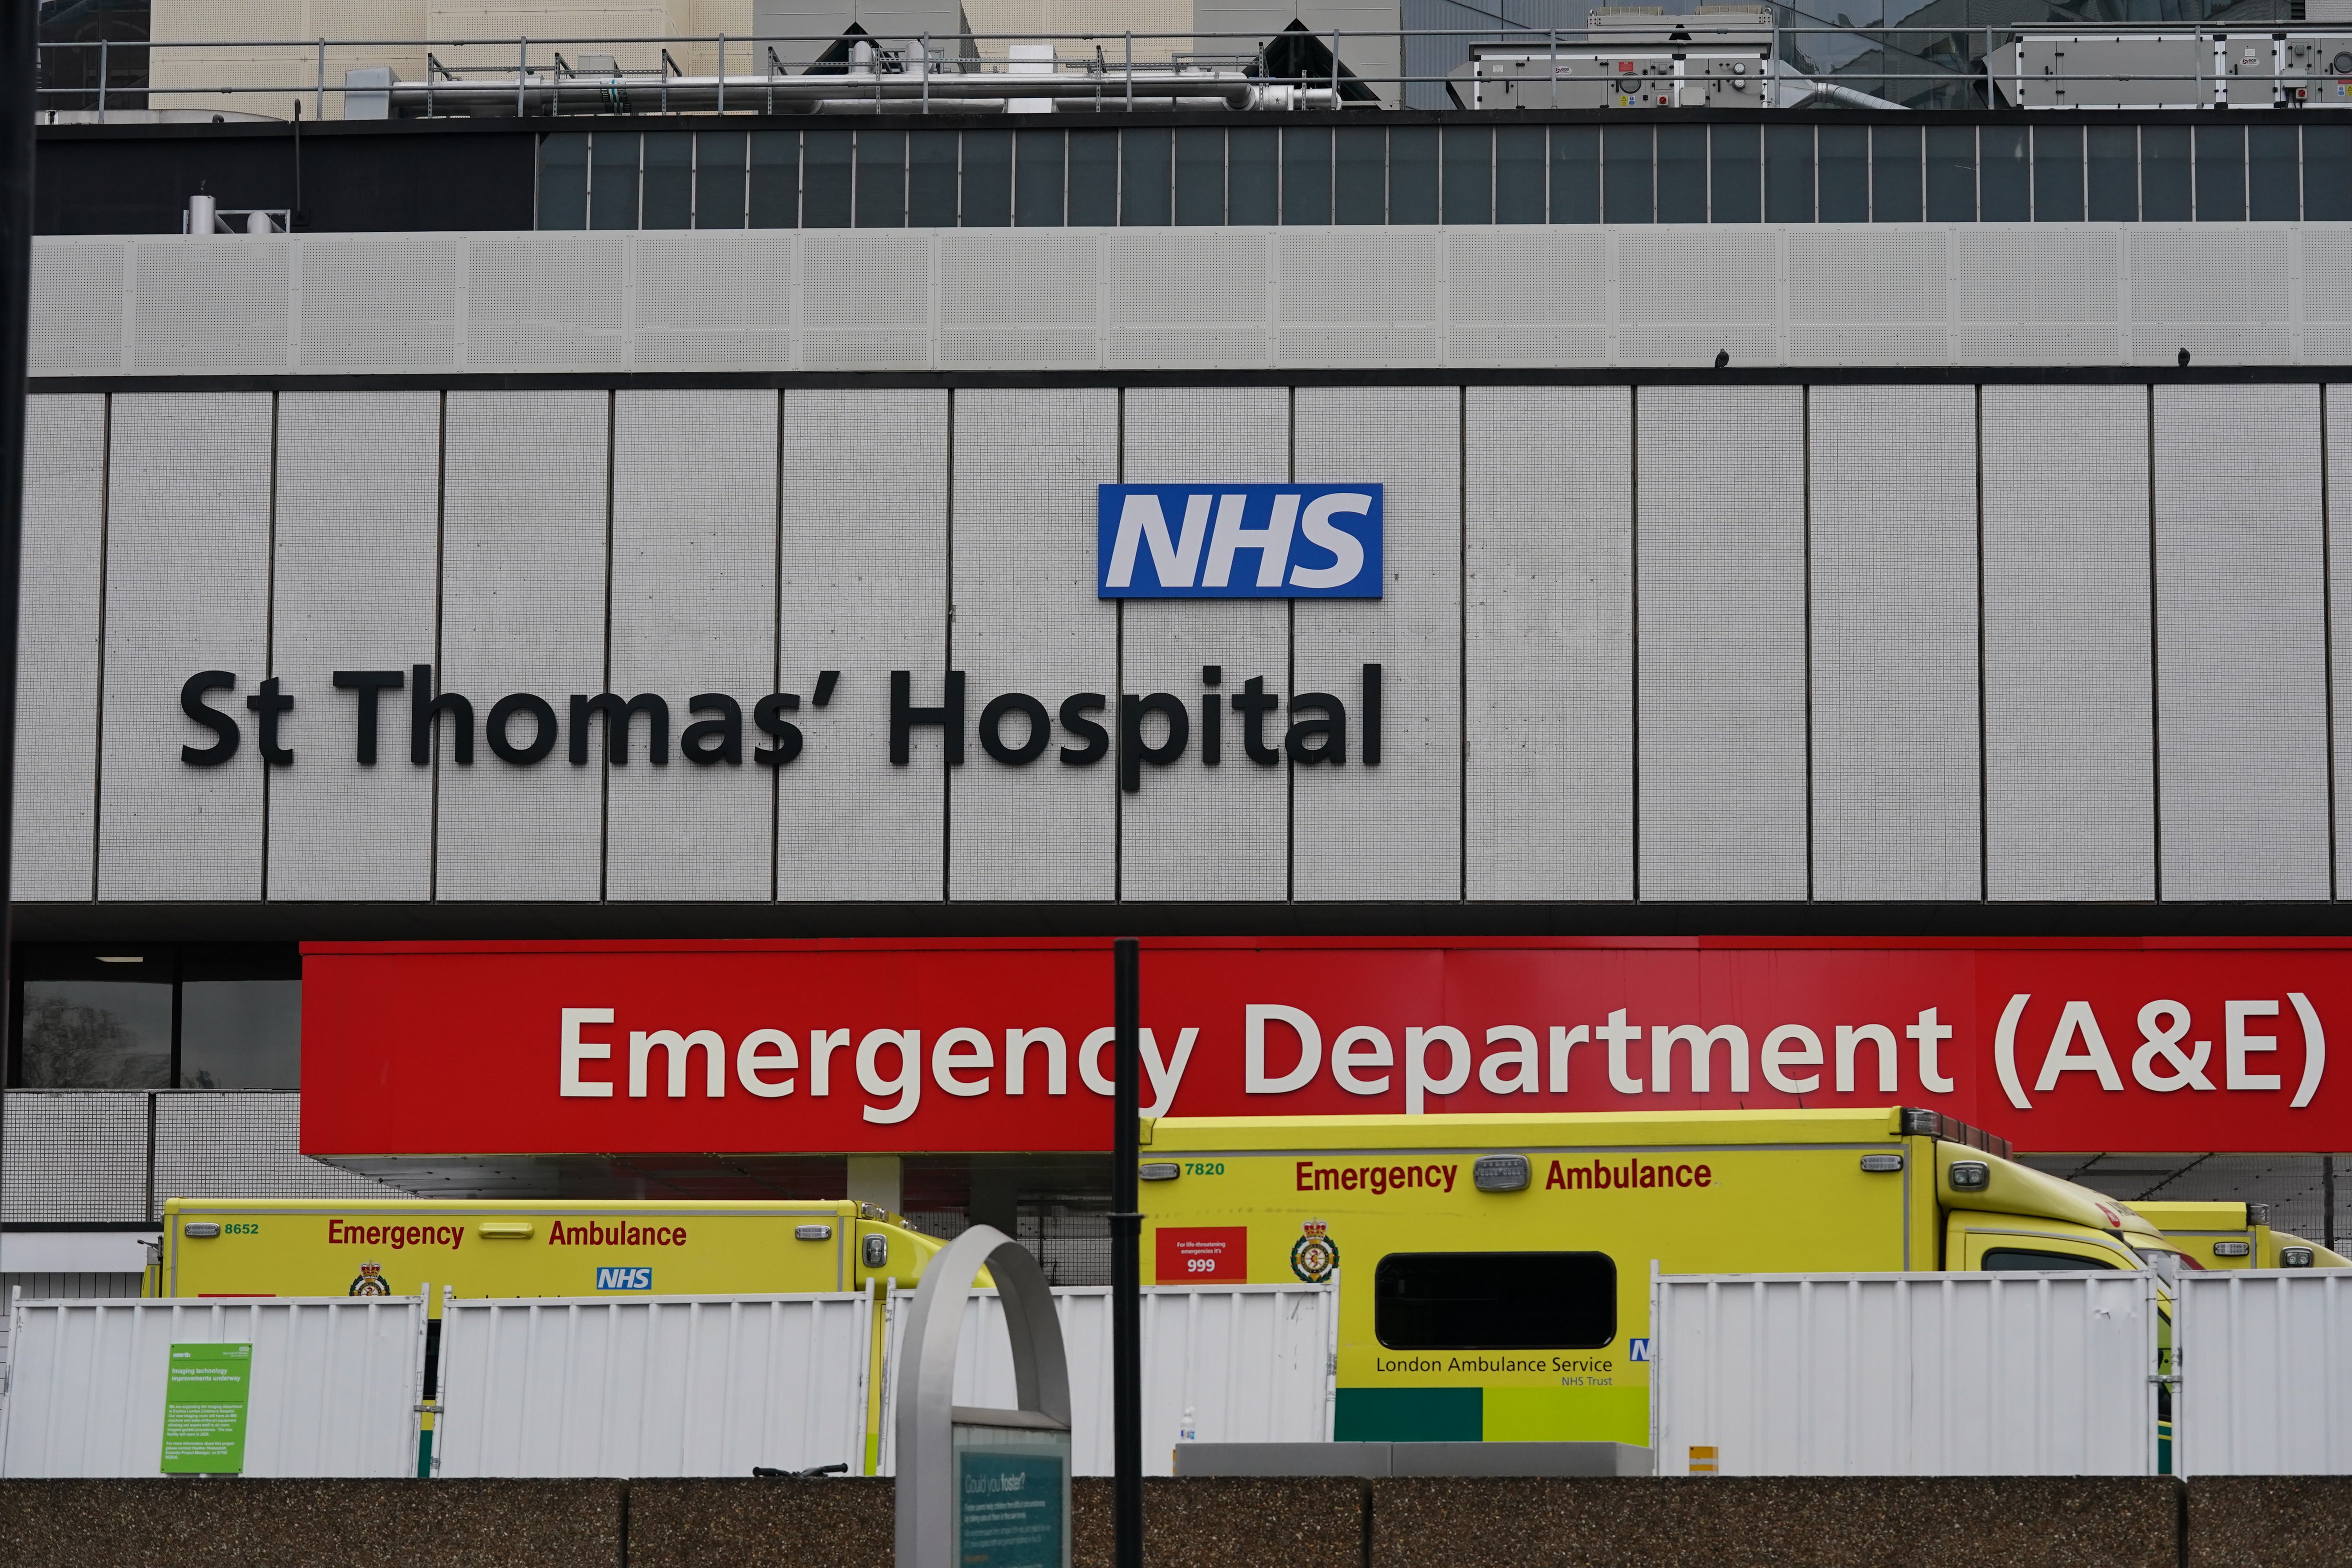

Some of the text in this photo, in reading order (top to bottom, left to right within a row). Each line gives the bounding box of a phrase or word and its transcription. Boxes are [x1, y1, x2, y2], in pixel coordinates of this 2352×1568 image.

[1105, 492, 1372, 588] NHS
[180, 663, 1382, 791] St Thomas' Hospital
[559, 992, 2325, 1124] Emergency Department (A&E)
[1185, 1163, 1225, 1175] 7820
[1296, 1158, 1712, 1195] Emergency Ambulance
[225, 1224, 259, 1234] 8652
[328, 1220, 686, 1249] Emergency Ambulance
[1187, 1259, 1215, 1272] 999
[598, 1269, 650, 1288] NHS
[1377, 1357, 1612, 1372] London Ambulance Service
[1562, 1377, 1612, 1386] NHS Trust
[965, 1474, 986, 1494] Could
[1001, 1472, 1025, 1491] foster?
